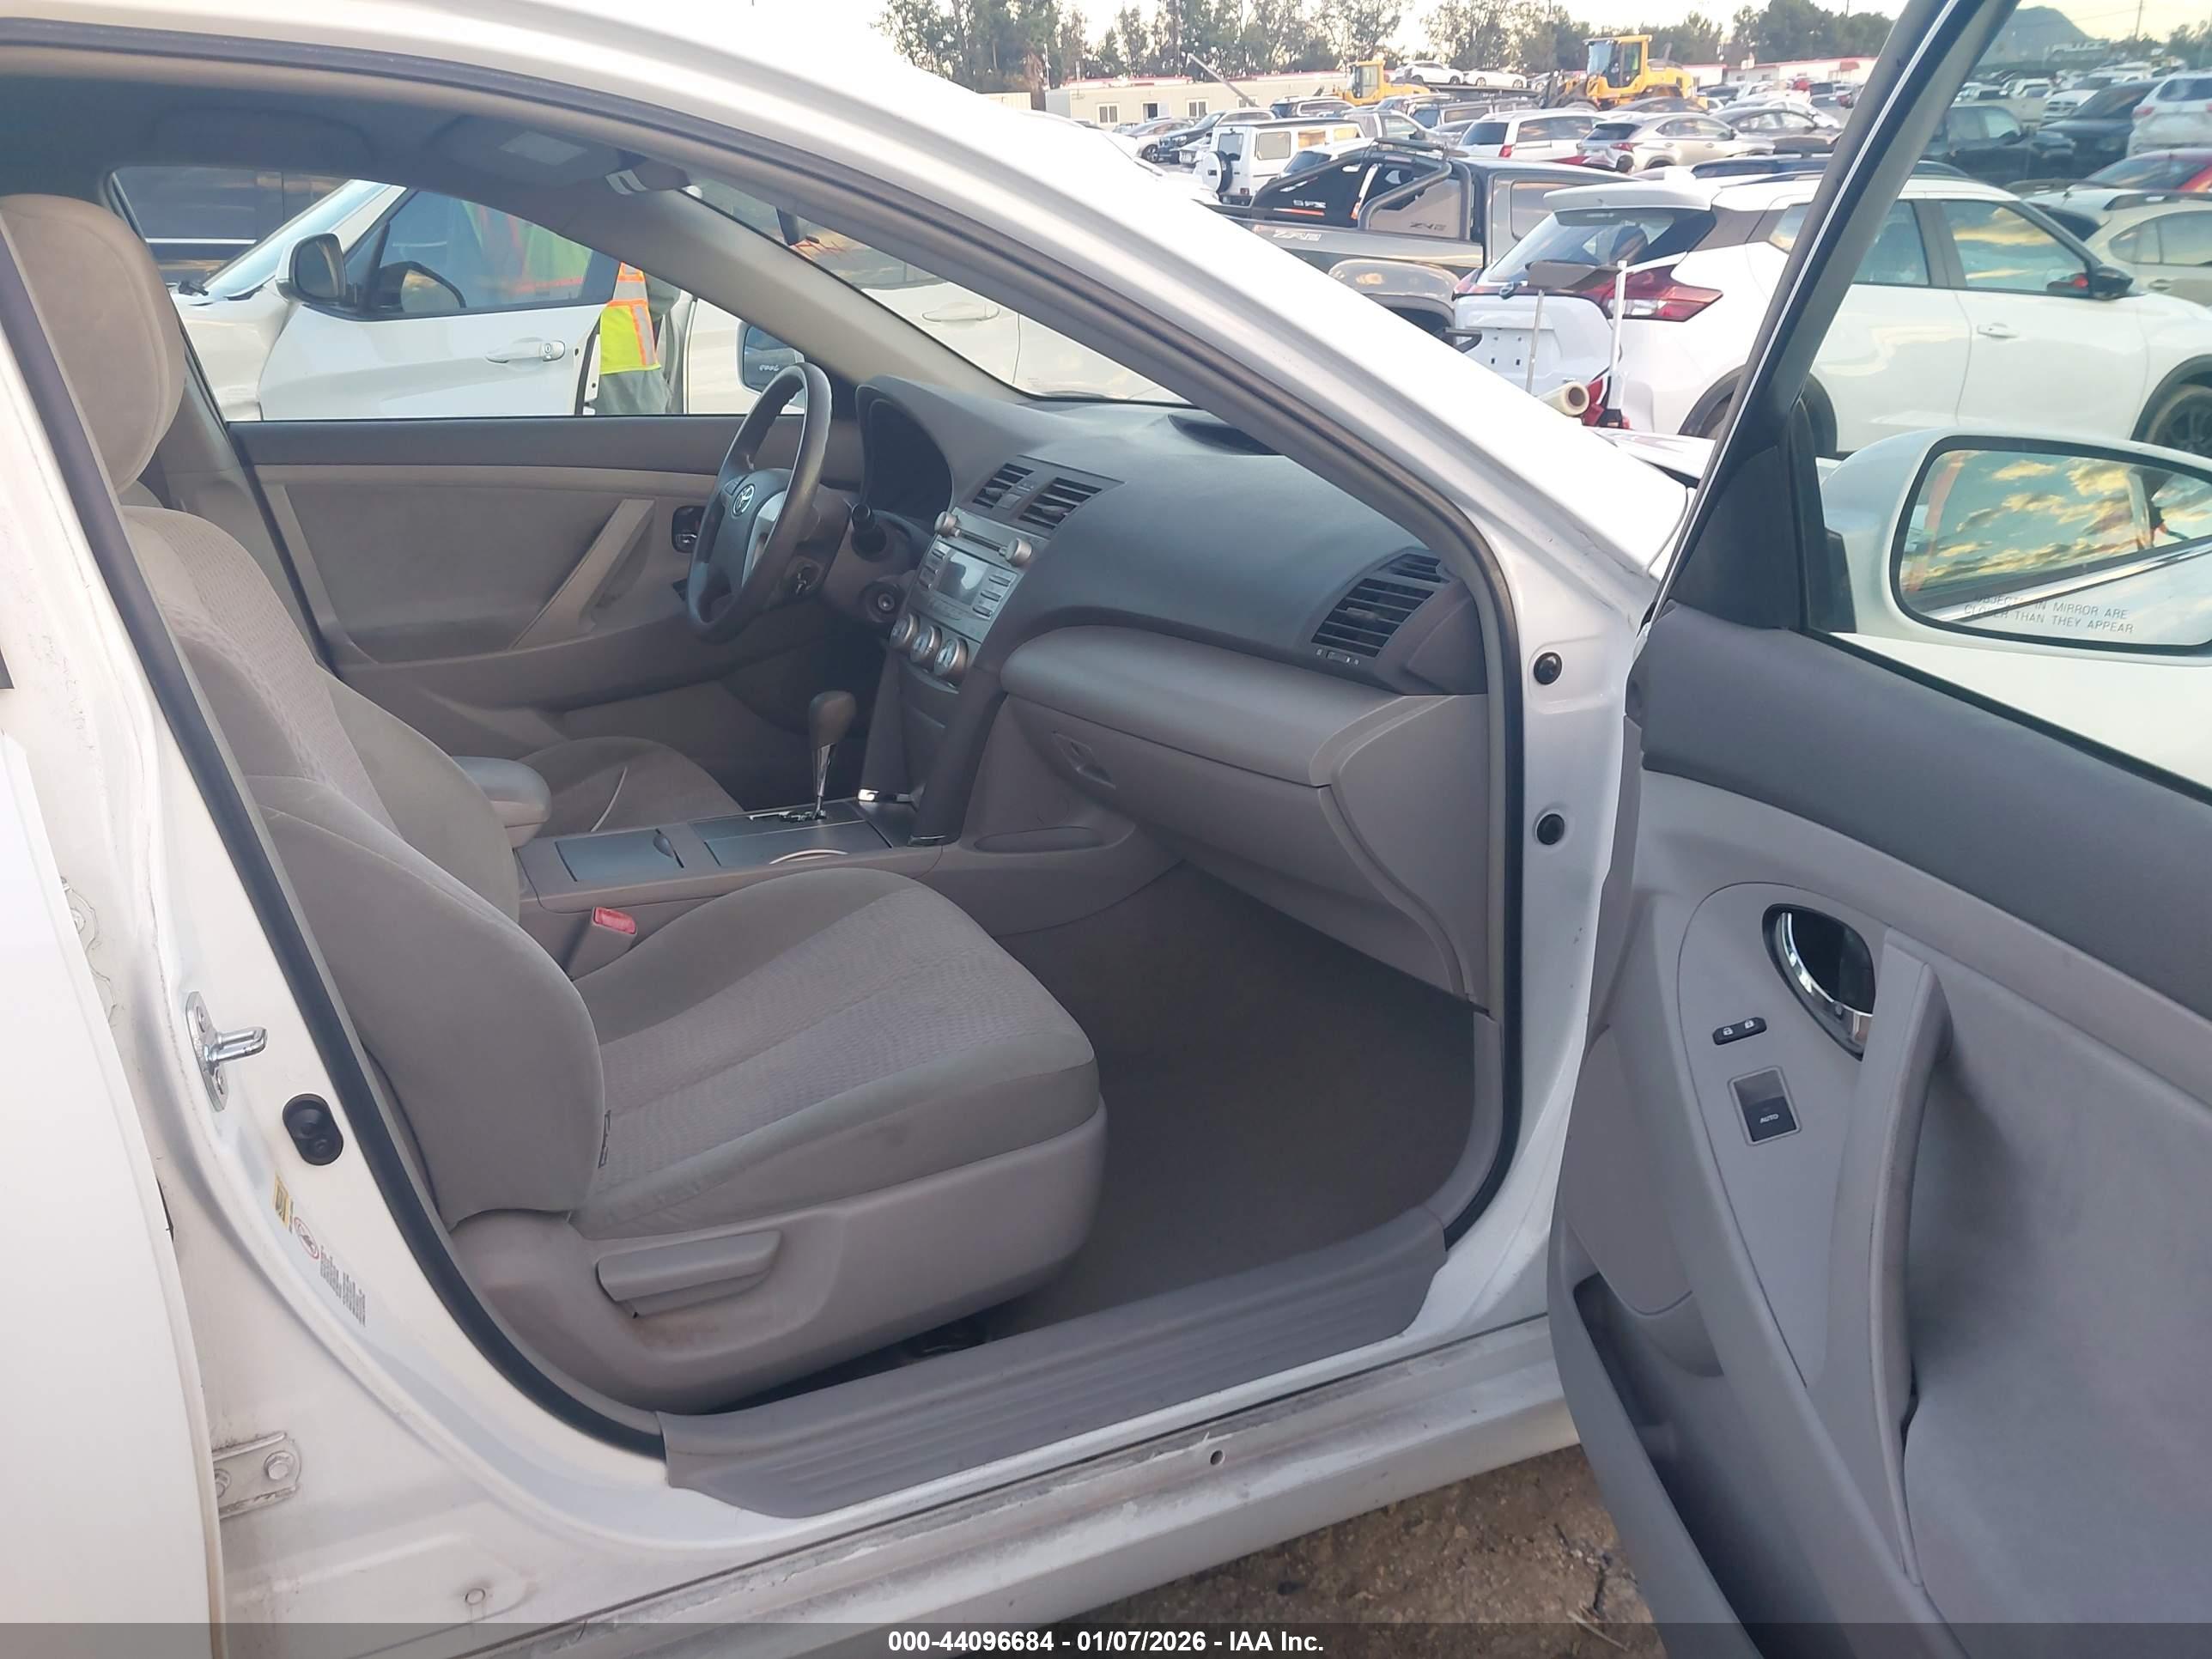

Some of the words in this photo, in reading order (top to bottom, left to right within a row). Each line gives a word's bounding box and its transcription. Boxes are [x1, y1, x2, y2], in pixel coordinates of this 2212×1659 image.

[2053, 601, 2099, 617] MIRROR
[2105, 608, 2130, 619] ARE
[2014, 611, 2045, 623] THAN
[2052, 615, 2081, 627] THEY
[2087, 620, 2134, 634] APPEAR
[1760, 1114, 1778, 1123] AUTO
